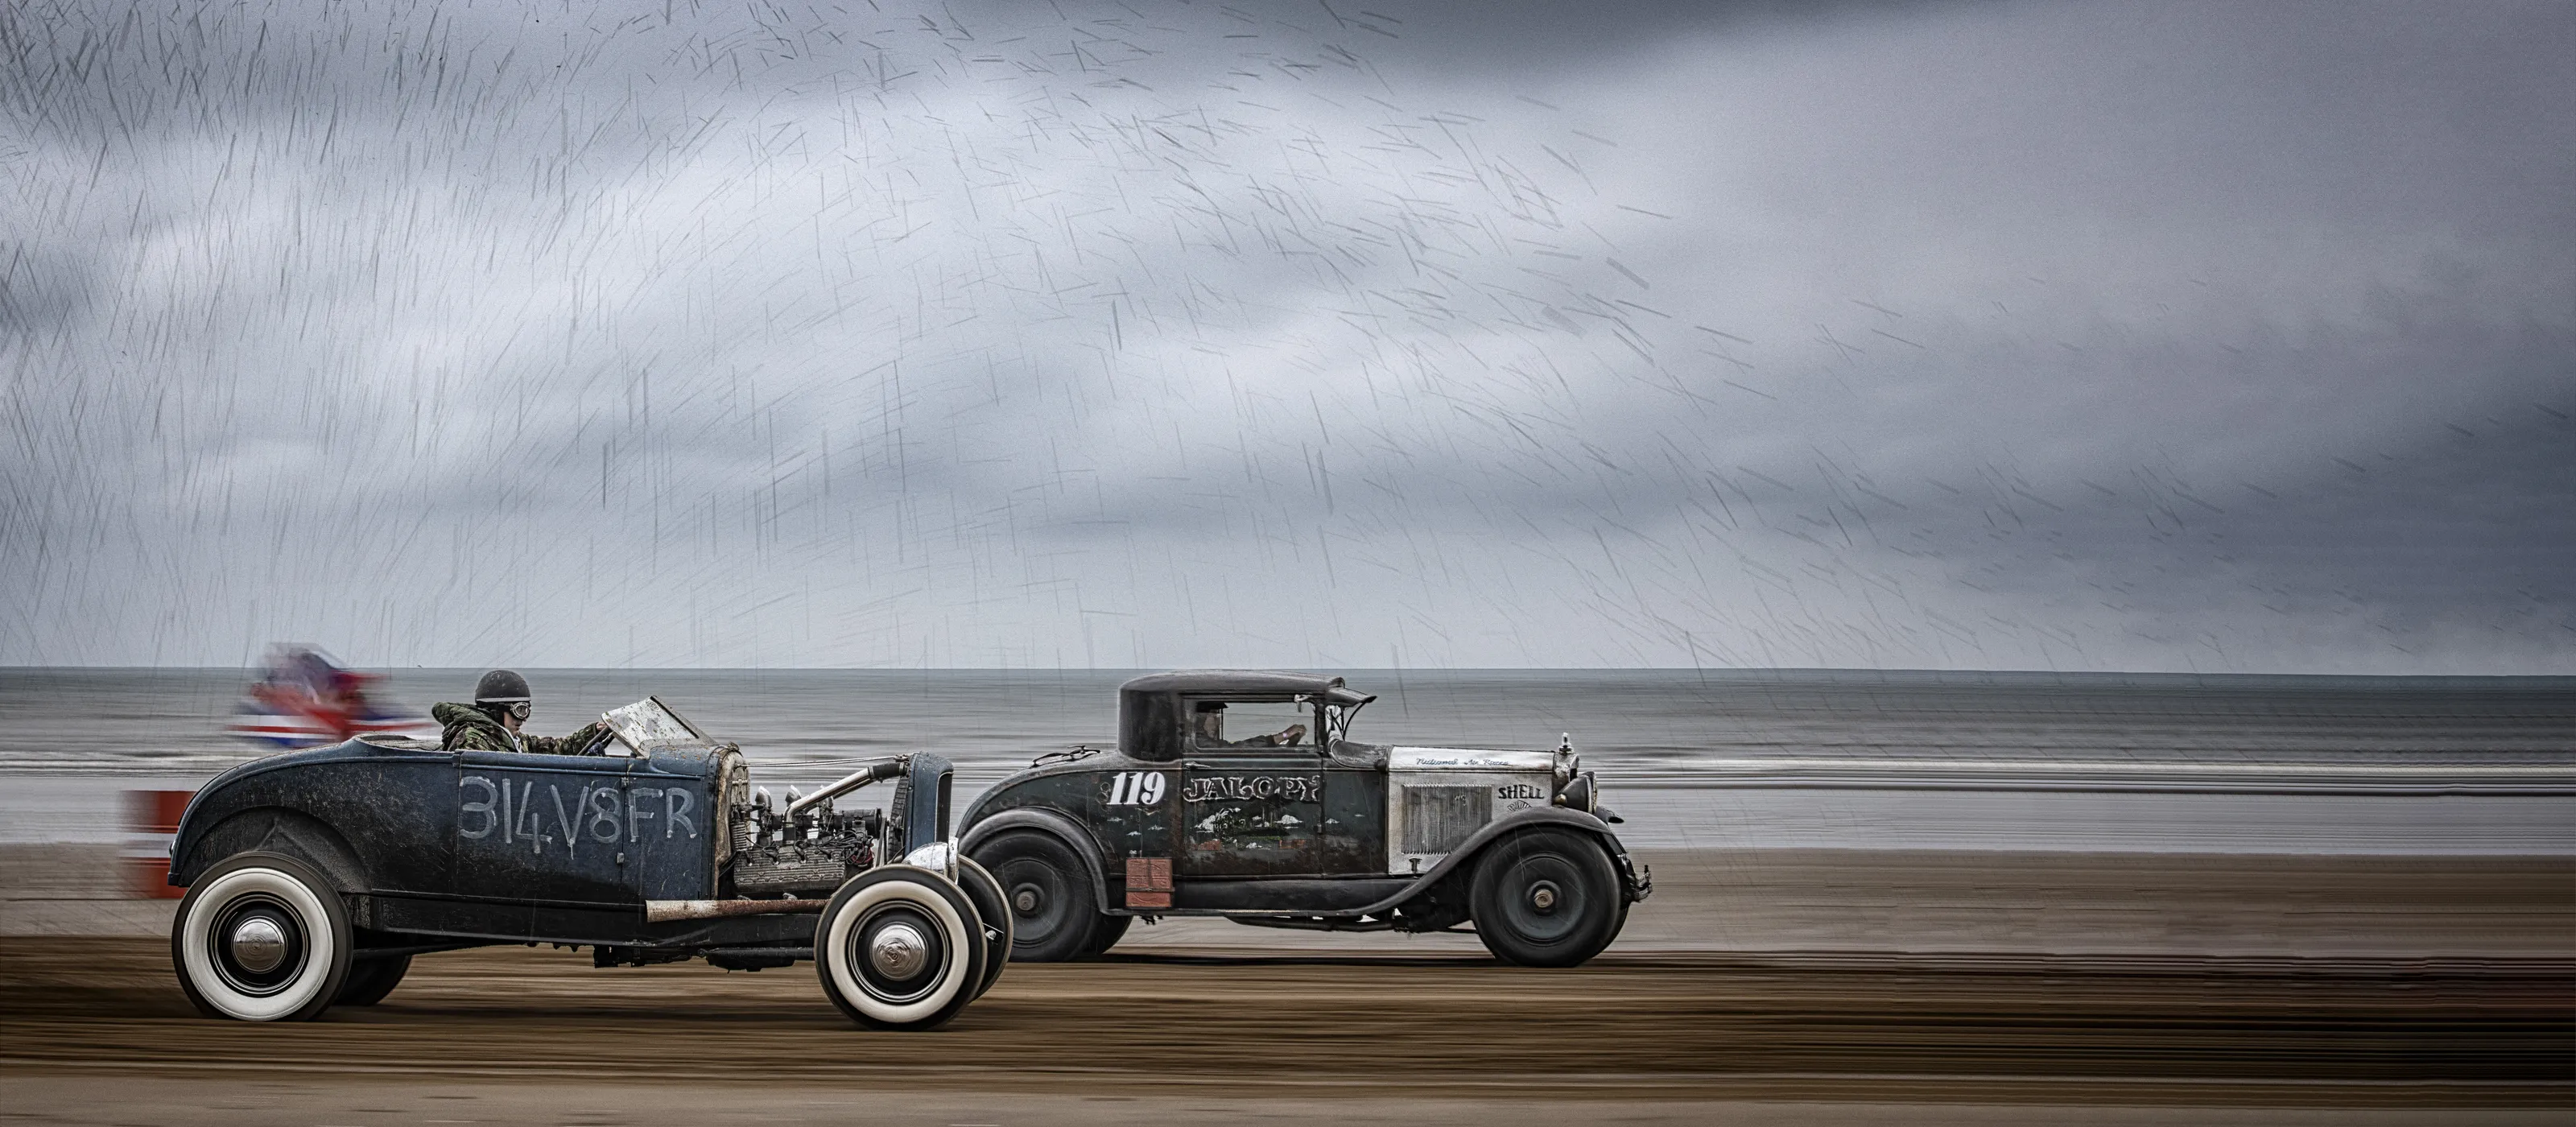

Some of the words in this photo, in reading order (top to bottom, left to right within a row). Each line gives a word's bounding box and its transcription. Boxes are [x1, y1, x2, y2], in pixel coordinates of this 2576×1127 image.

[1106, 771, 1166, 805] 119
[1183, 775, 1321, 803] JALOPY
[1498, 784, 1545, 799] SHELL
